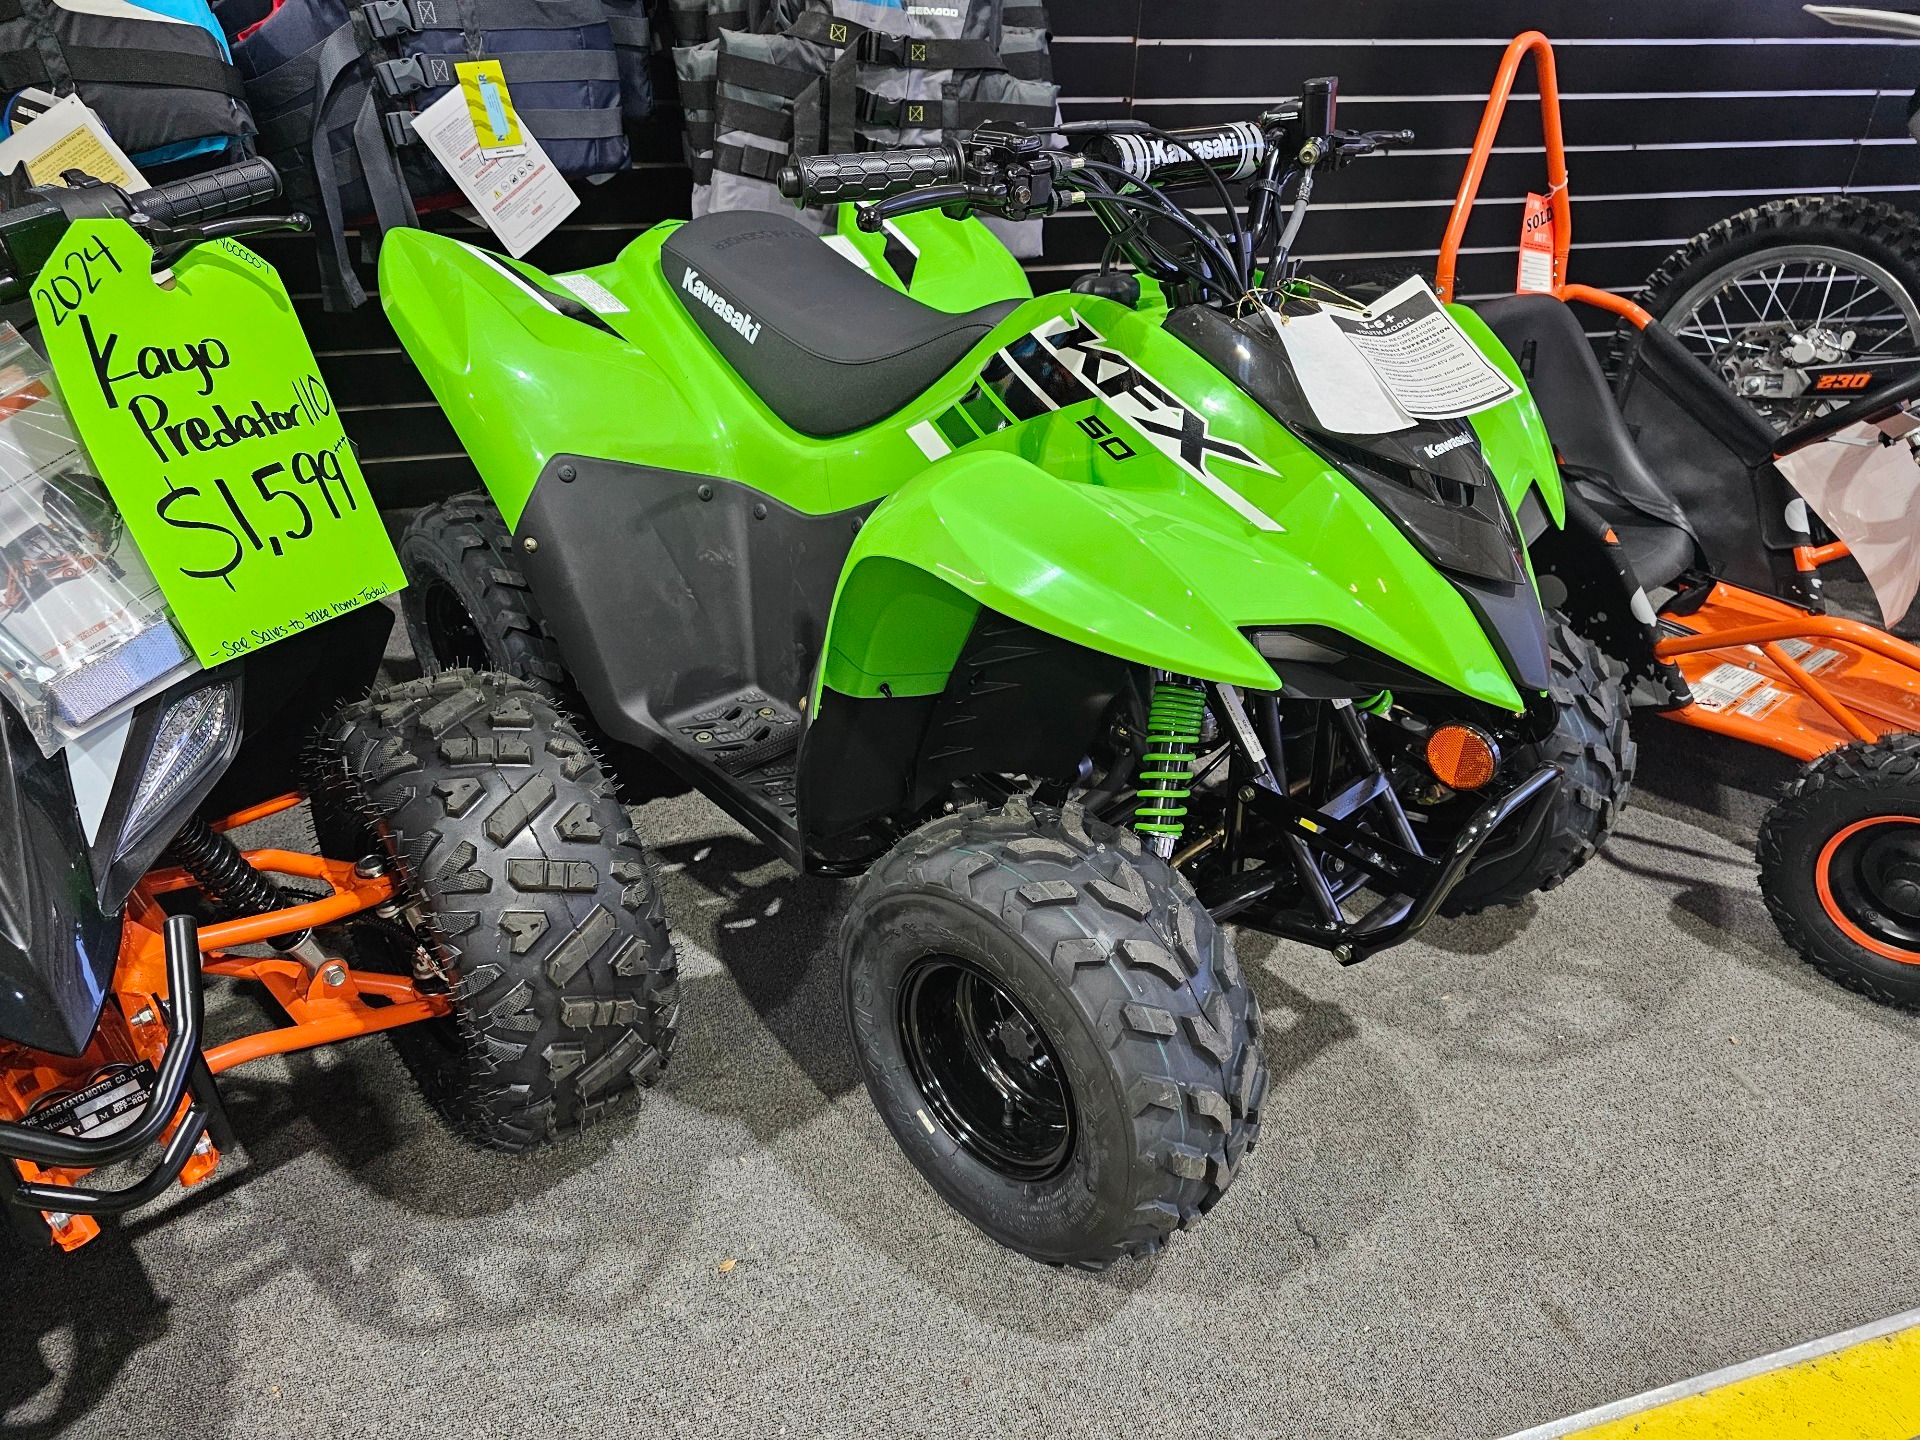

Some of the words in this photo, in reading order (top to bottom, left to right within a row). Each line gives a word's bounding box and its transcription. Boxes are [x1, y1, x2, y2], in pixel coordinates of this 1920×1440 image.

[1150, 132, 1239, 165] Kawasaki
[1527, 207, 1553, 232] SOLD
[37, 234, 122, 326] 2024
[681, 266, 762, 345] Kawasaki
[1355, 328, 1383, 336] YOUTH
[1383, 317, 1414, 335] MODEL
[1388, 316, 1441, 342] RECREATIONAL
[1400, 326, 1437, 345] OPERATORS
[1401, 326, 1451, 351] SUPERVISION
[79, 314, 230, 409] Kayo
[1419, 343, 1455, 361] PASSENGERS
[1816, 373, 1872, 390] 230
[1040, 312, 1272, 483] KFX
[128, 394, 300, 463] Predator
[292, 374, 330, 426] 110
[1075, 415, 1137, 462] 50
[1423, 431, 1474, 459] Kawasaki
[251, 625, 288, 645] Sales
[288, 619, 305, 630] to
[305, 608, 333, 624] take
[330, 597, 361, 614] home
[39, 1105, 62, 1121] JIANG
[62, 1094, 85, 1110] KAYO
[85, 1081, 113, 1100] MOTOR
[99, 1112, 110, 1121] M
